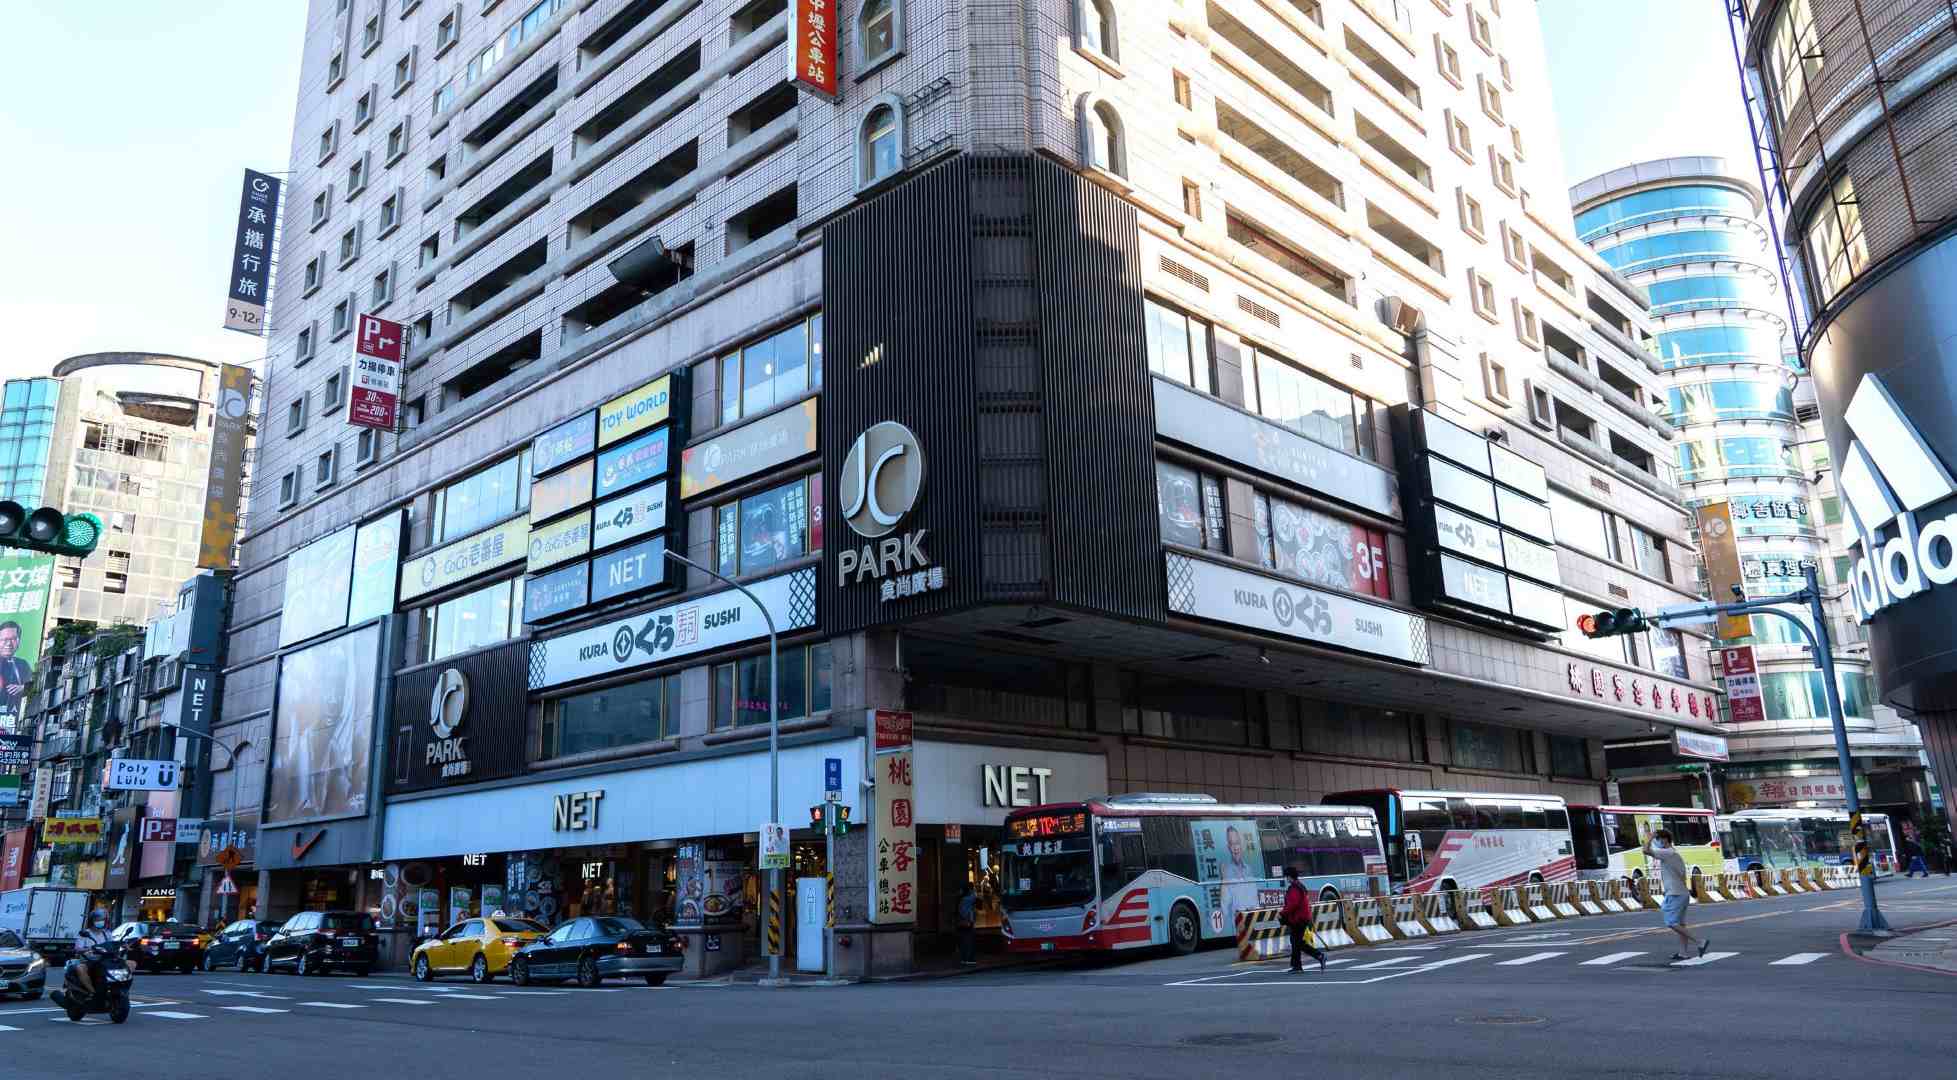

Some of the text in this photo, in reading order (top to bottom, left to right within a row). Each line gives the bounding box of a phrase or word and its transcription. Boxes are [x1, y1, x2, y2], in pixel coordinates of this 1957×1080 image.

[238, 206, 266, 297] 承攜行旅
[364, 318, 380, 341] P
[602, 391, 667, 431] TOY WORLD
[608, 553, 648, 587] NET
[838, 528, 928, 587] PARK
[1357, 541, 1384, 581] 3F
[1234, 588, 1268, 610] KURA
[1354, 617, 1384, 638] SUSHI
[578, 641, 609, 662] KURA
[703, 607, 741, 630] SUSHI
[192, 677, 206, 722] NET
[119, 762, 149, 775] Poly
[426, 738, 466, 766] PARK
[983, 764, 1052, 808] NET
[146, 820, 161, 840] P
[553, 789, 605, 832] NET
[888, 757, 916, 914] 桃園客運
[463, 854, 488, 866] NET
[581, 862, 603, 879] NET
